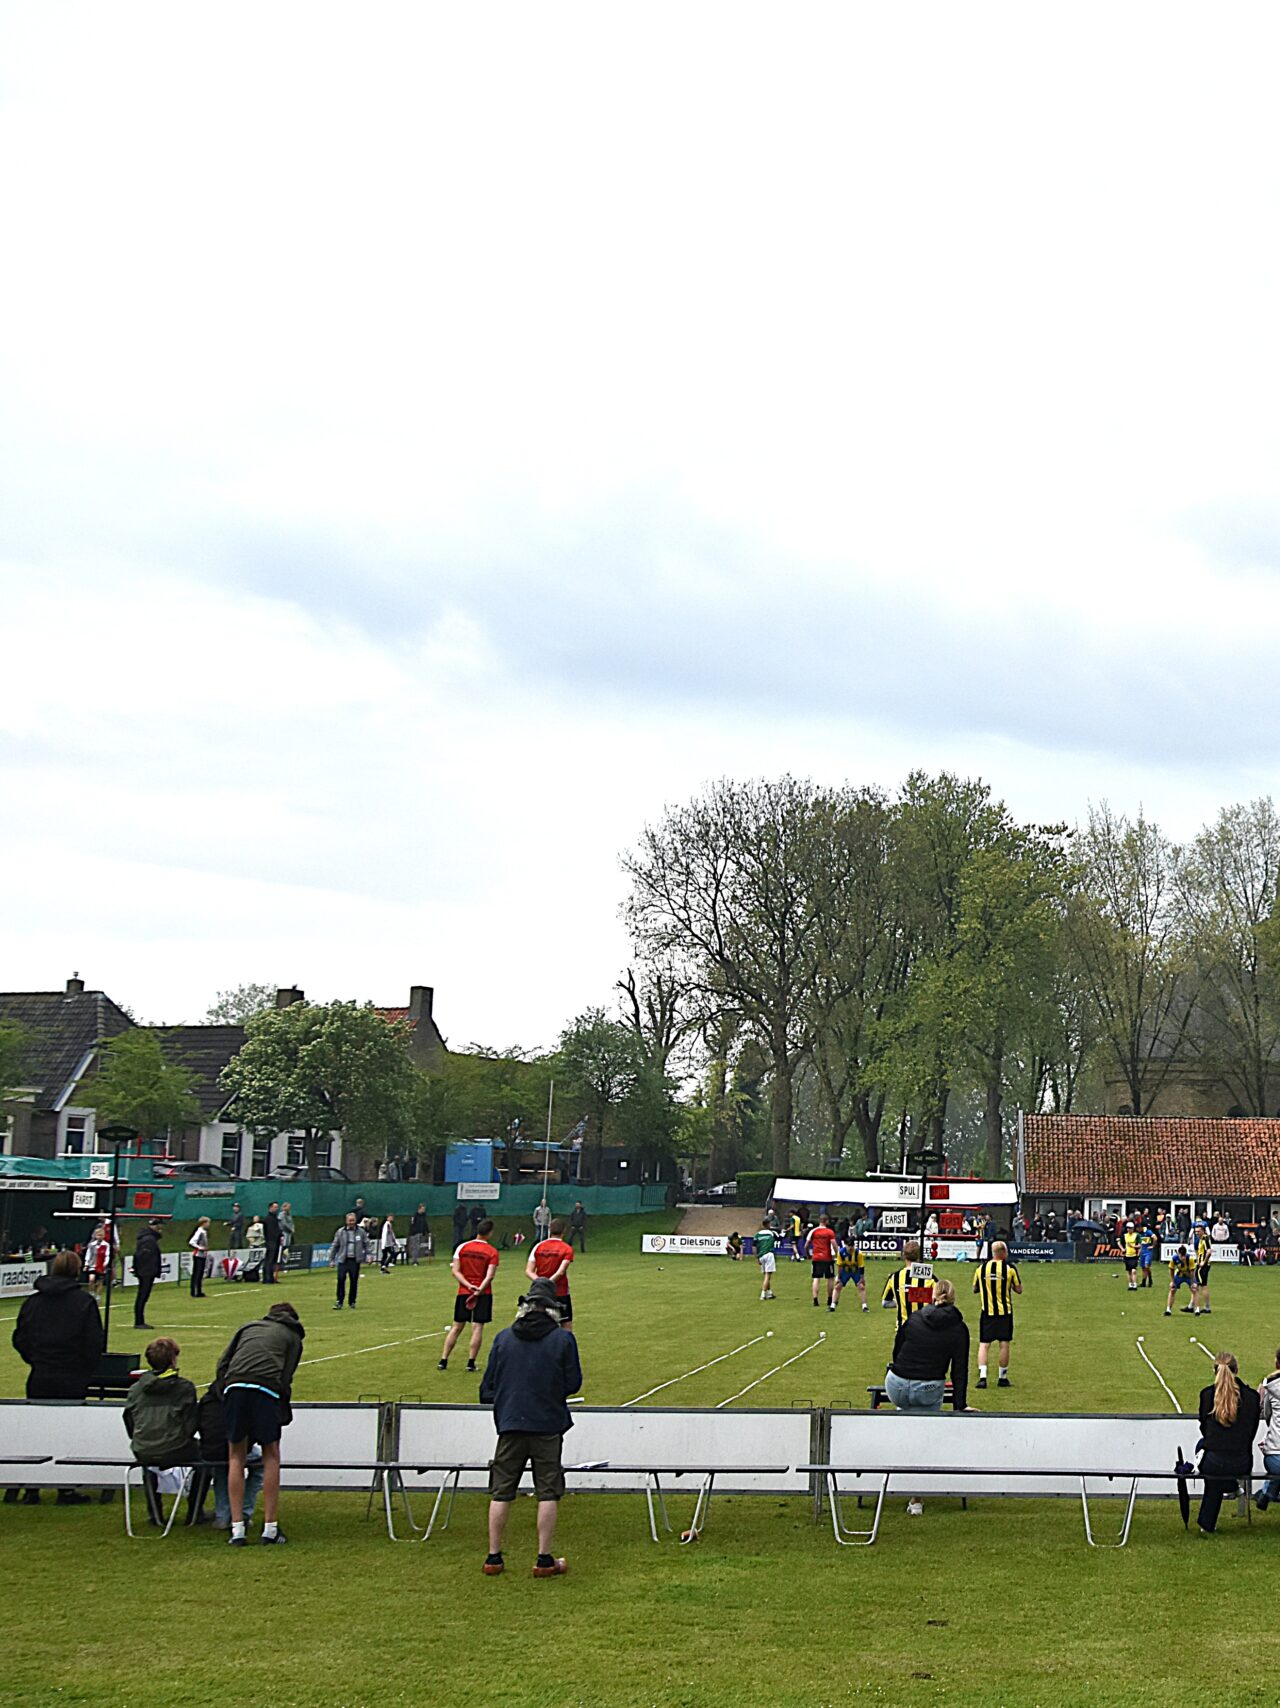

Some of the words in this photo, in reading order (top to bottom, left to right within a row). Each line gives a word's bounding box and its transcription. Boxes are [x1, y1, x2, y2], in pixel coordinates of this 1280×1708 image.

[900, 1186, 916, 1196] SPUL
[75, 1195, 94, 1206] EARST
[885, 1215, 905, 1225] EARST
[669, 1237, 676, 1246] It
[1222, 1249, 1238, 1257] HM
[913, 1266, 931, 1277] KEATS
